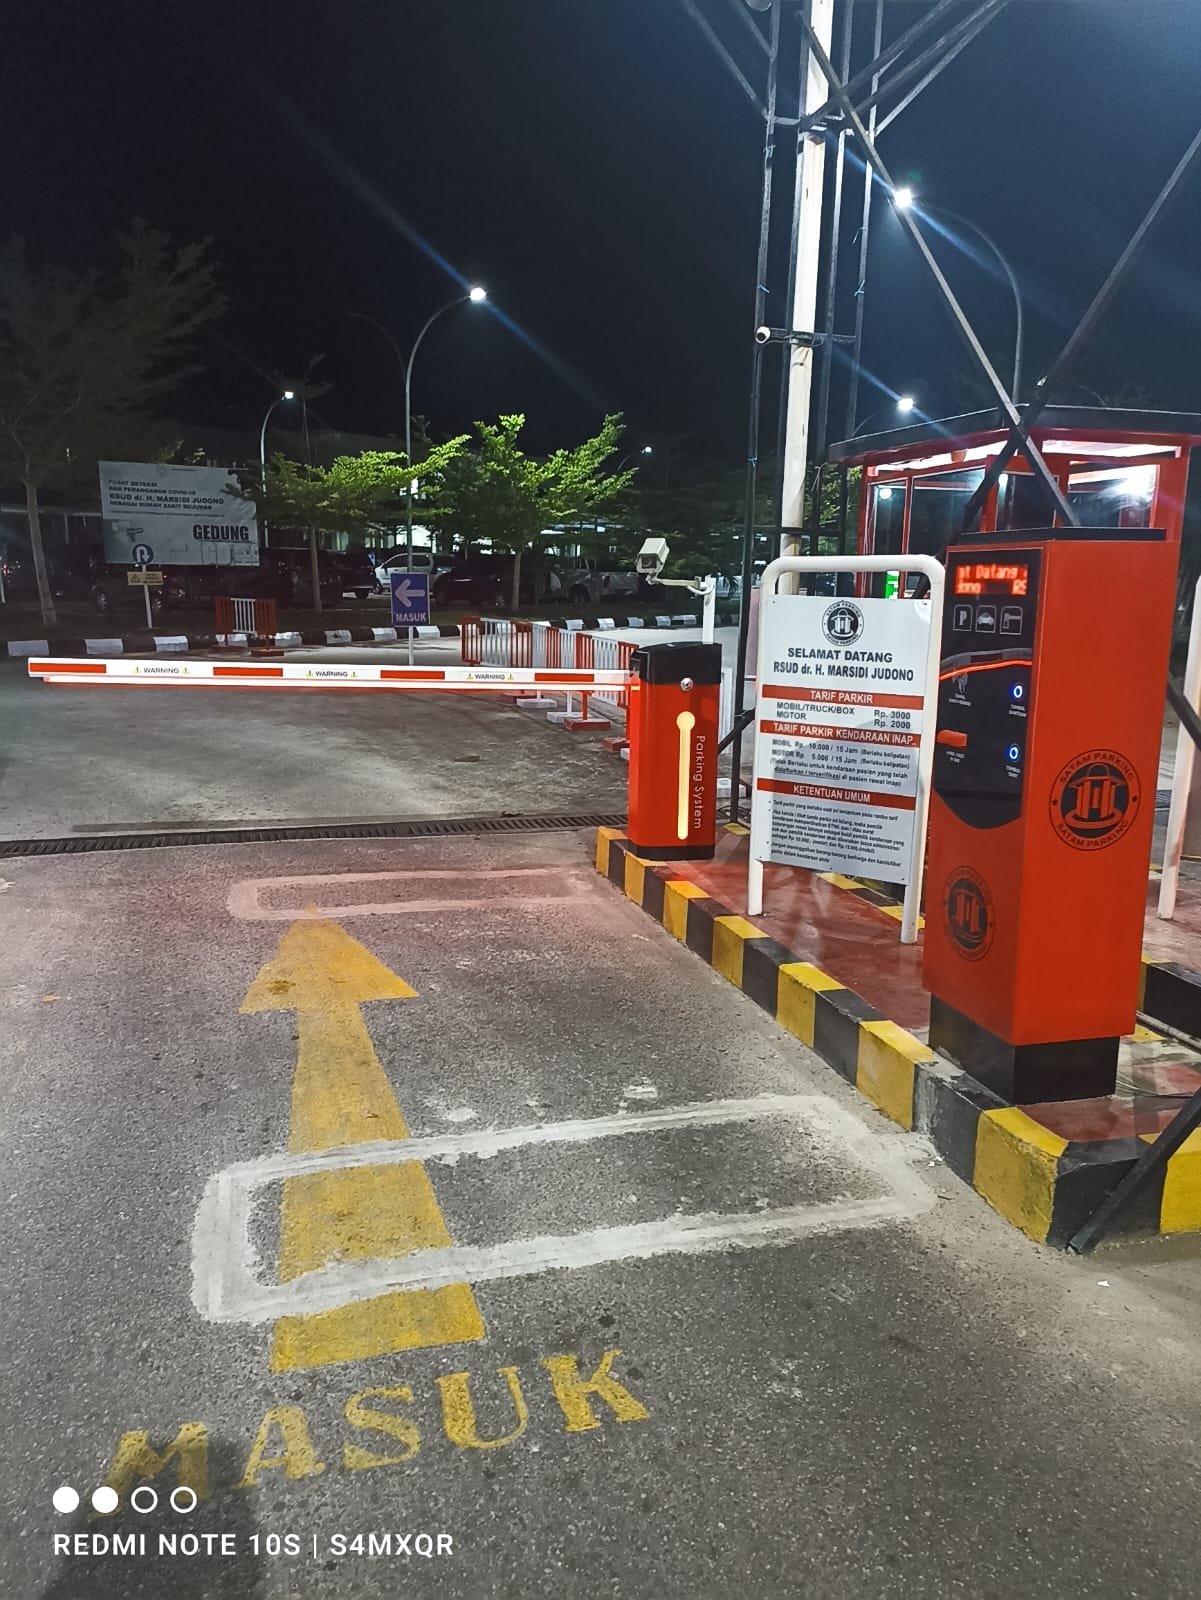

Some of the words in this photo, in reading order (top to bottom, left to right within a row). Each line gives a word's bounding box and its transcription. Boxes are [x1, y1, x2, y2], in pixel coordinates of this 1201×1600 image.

[193, 524, 248, 540] GEDUNG
[396, 613, 426, 621] MASUK
[959, 610, 967, 625] P
[788, 648, 841, 660] SELAMAT
[845, 650, 892, 663] DATANG
[774, 662, 798, 674] RSUD
[801, 663, 812, 674] dr.
[815, 664, 824, 675] H.
[828, 664, 868, 678] MARSIDI
[872, 667, 913, 681] JUDONO
[810, 690, 835, 700] TARIF
[838, 693, 873, 703] PARKIR
[777, 702, 855, 715] MOBIL/TRUCK/BOX
[874, 710, 888, 719] Rp.
[891, 711, 910, 720] 3000
[777, 711, 806, 720] MOTOR
[874, 719, 888, 728] Rp.
[890, 720, 910, 729] 2000
[773, 723, 798, 732] TARIF
[801, 727, 833, 736] PARKIR
[836, 731, 890, 742] KENDARAAN
[892, 735, 913, 744] INAP
[693, 736, 706, 782] Parking
[1094, 753, 1134, 780] PARKING
[793, 785, 843, 799] KETENTUAN
[845, 790, 870, 802] UMUM
[694, 786, 704, 829] System
[1087, 820, 1128, 847] PARKING
[88, 1348, 651, 1517] MASUK
